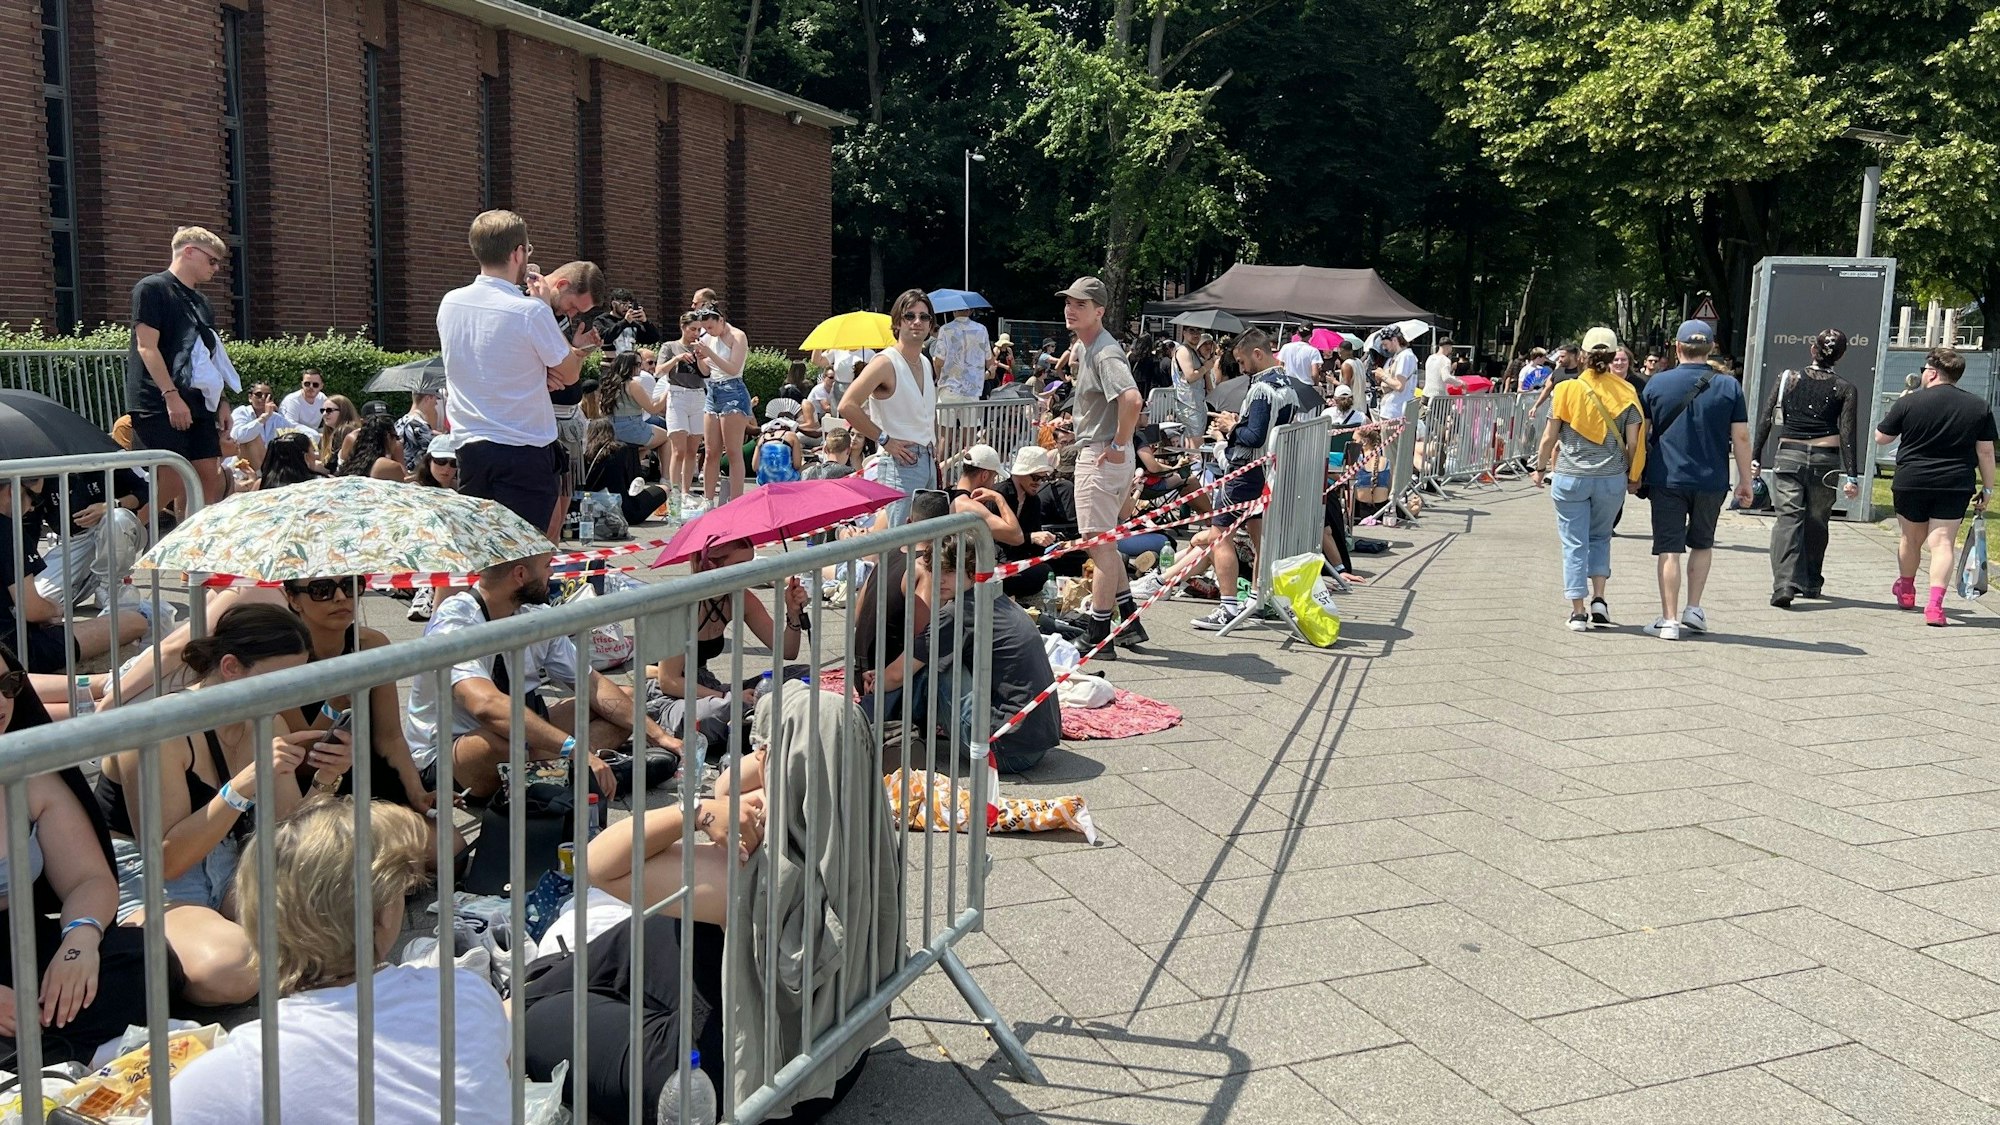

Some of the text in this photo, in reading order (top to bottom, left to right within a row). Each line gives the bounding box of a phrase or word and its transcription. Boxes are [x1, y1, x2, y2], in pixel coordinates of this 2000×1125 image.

[1774, 333, 1869, 346] me-re.de
[592, 636, 616, 644] frisc
[701, 812, 716, 827] 82
